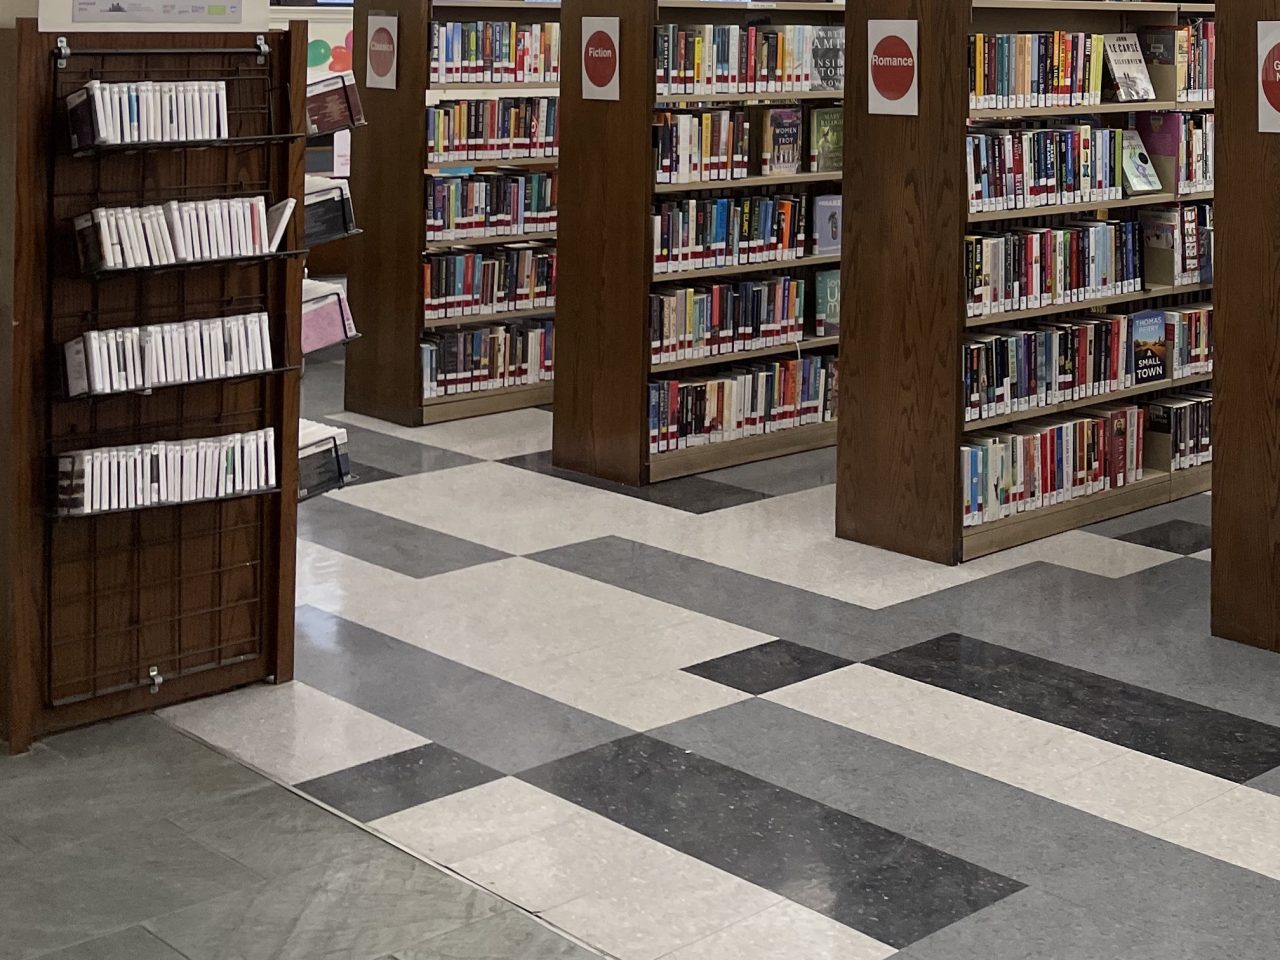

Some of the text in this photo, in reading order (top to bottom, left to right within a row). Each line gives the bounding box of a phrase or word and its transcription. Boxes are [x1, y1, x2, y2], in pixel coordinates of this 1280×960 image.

[370, 42, 394, 52] Classics
[814, 39, 844, 48] AMI
[1109, 44, 1117, 52] LE
[588, 48, 612, 58] Fiction
[872, 55, 913, 66] Romance
[778, 136, 794, 144] TROY
[1014, 173, 1023, 196] NEVER
[1136, 316, 1162, 326] THOMAS
[1138, 324, 1158, 334] PERRY
[1138, 358, 1161, 368] SMALL
[1136, 368, 1163, 380] TOWN
